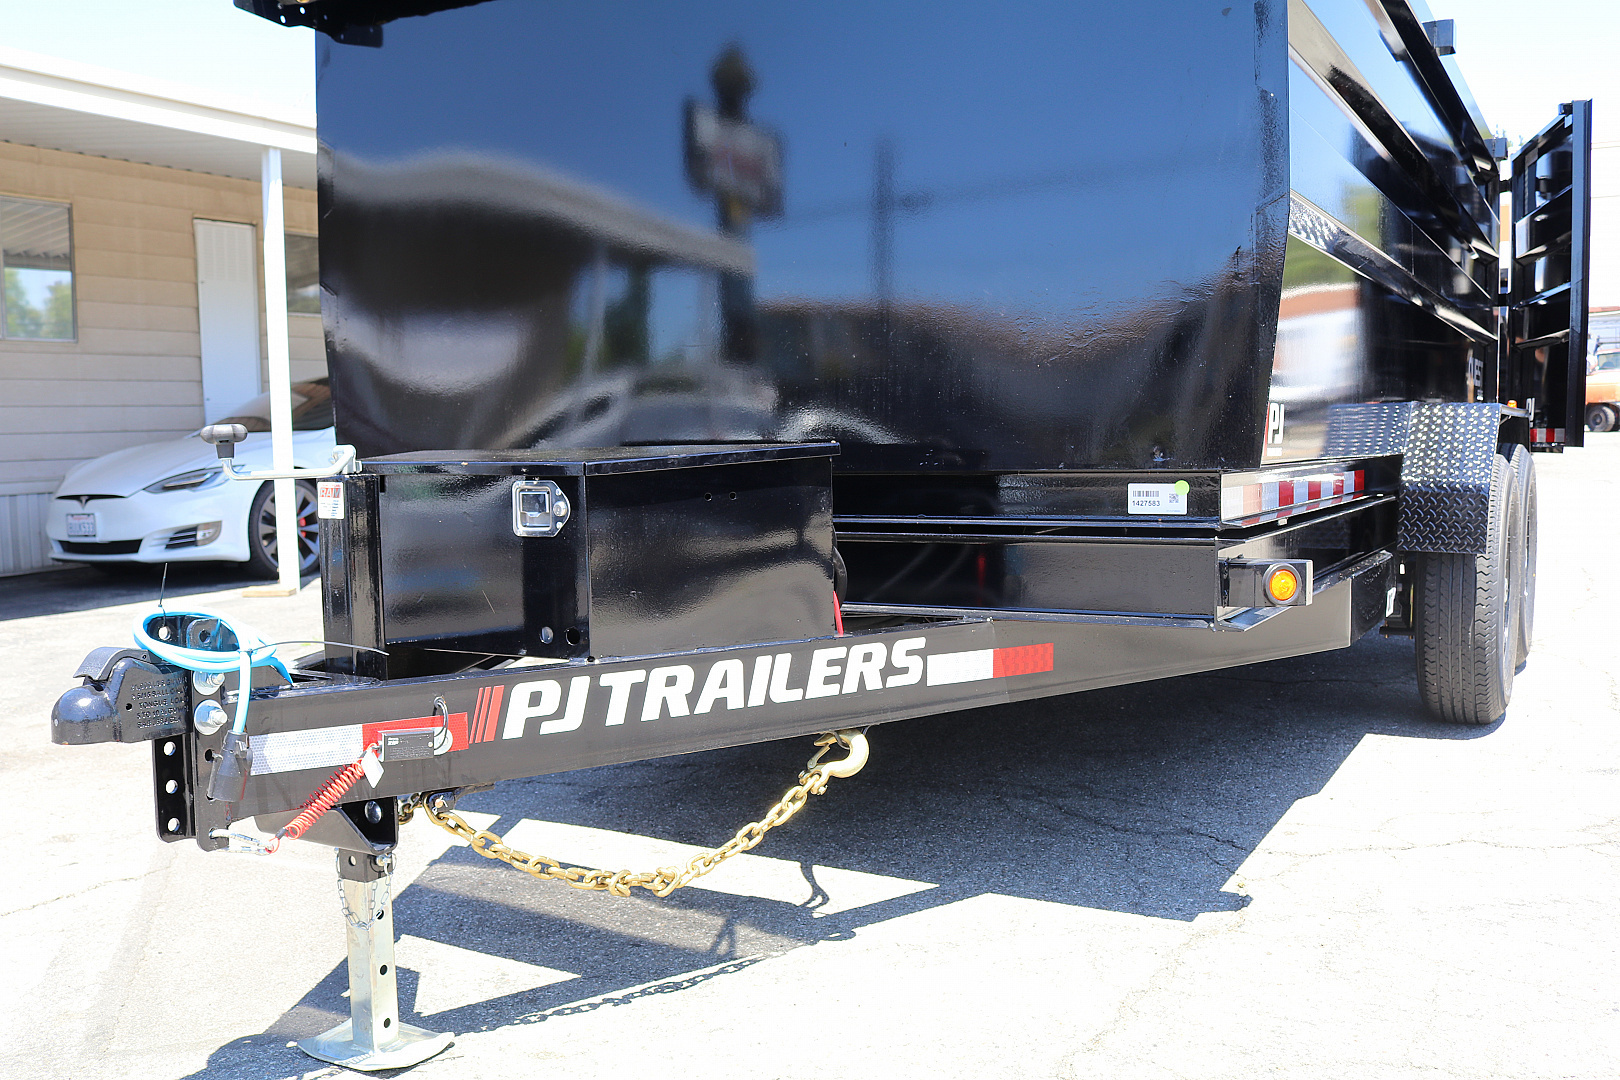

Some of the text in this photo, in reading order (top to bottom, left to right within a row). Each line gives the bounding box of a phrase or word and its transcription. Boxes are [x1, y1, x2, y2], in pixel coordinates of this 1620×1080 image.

[1267, 402, 1285, 444] PJ
[152, 689, 169, 697] BALL
[502, 636, 927, 740] PJ TRAILERS
[139, 698, 168, 710] TONGUE
